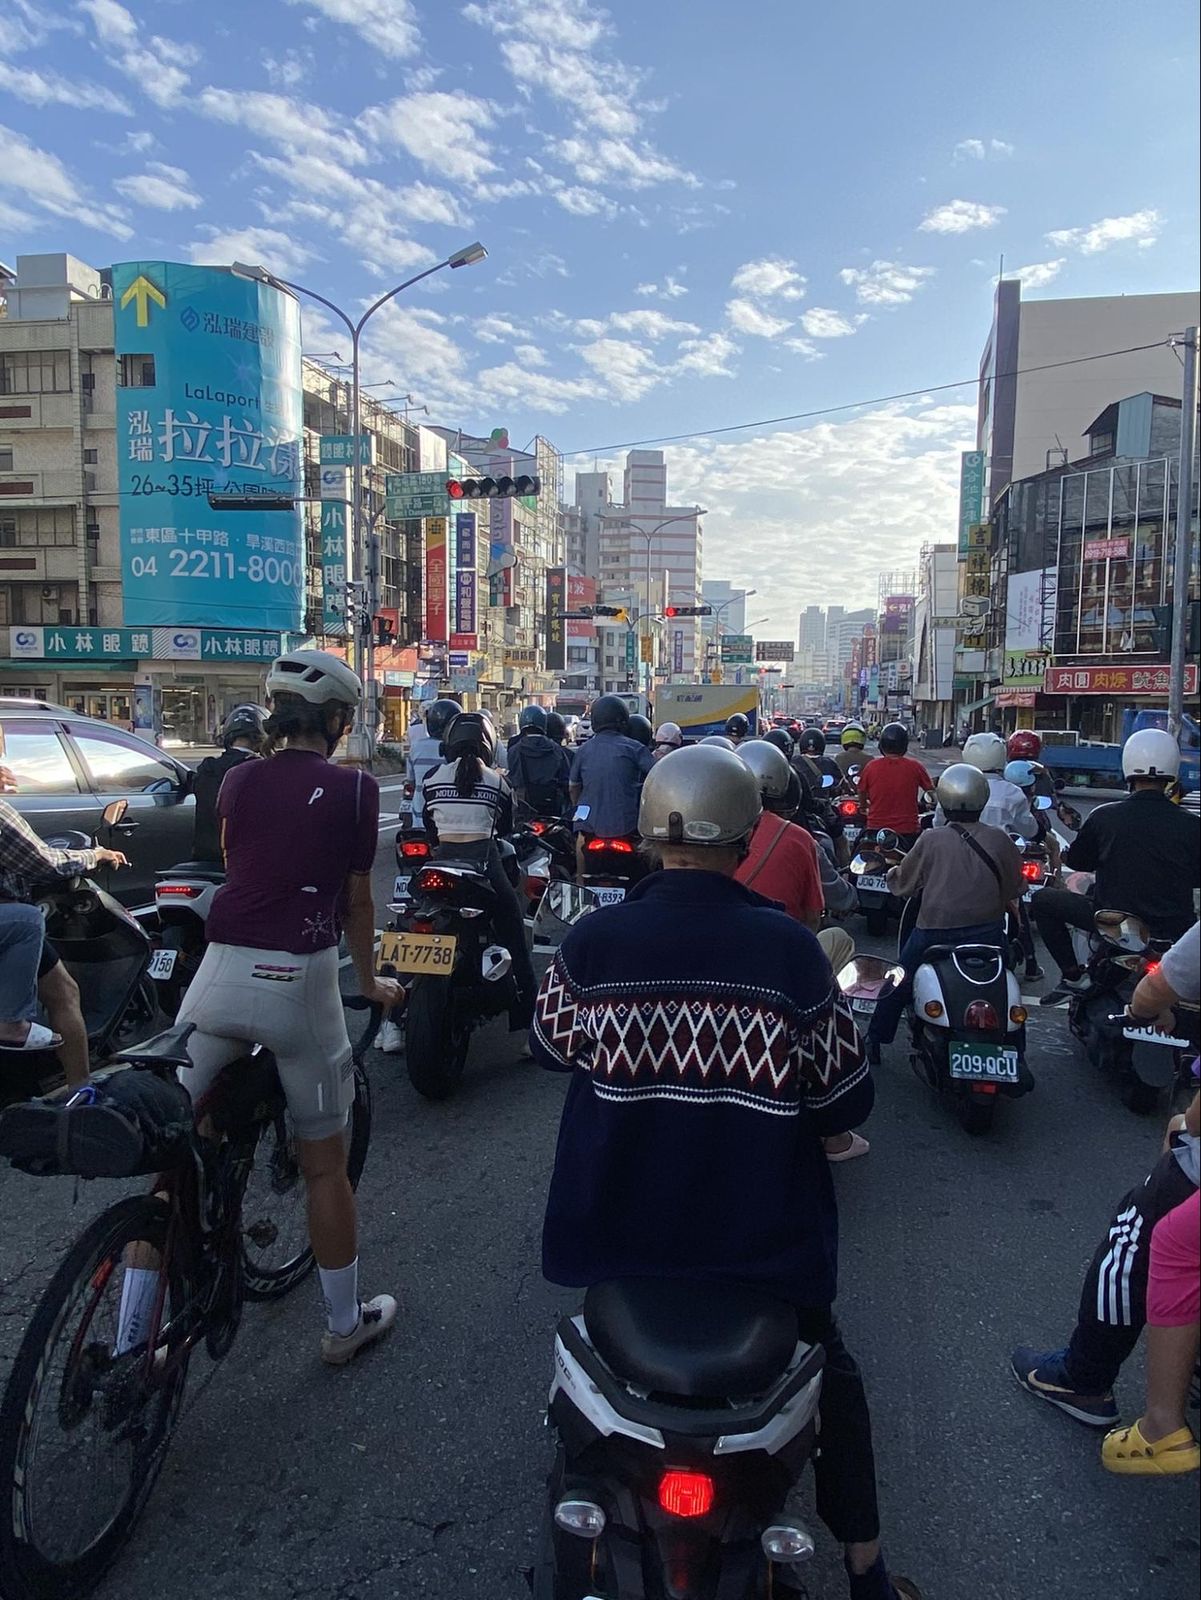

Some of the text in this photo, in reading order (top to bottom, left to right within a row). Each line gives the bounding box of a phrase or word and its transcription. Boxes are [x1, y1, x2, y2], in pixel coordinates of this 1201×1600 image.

[128, 410, 153, 462] 泓瑞
[145, 527, 229, 547] 東區十甲路
[131, 556, 158, 577] 04
[48, 632, 150, 654] 小林眼鏡
[204, 636, 280, 657] 小林眼鏡
[1056, 671, 1090, 689] 肉圓
